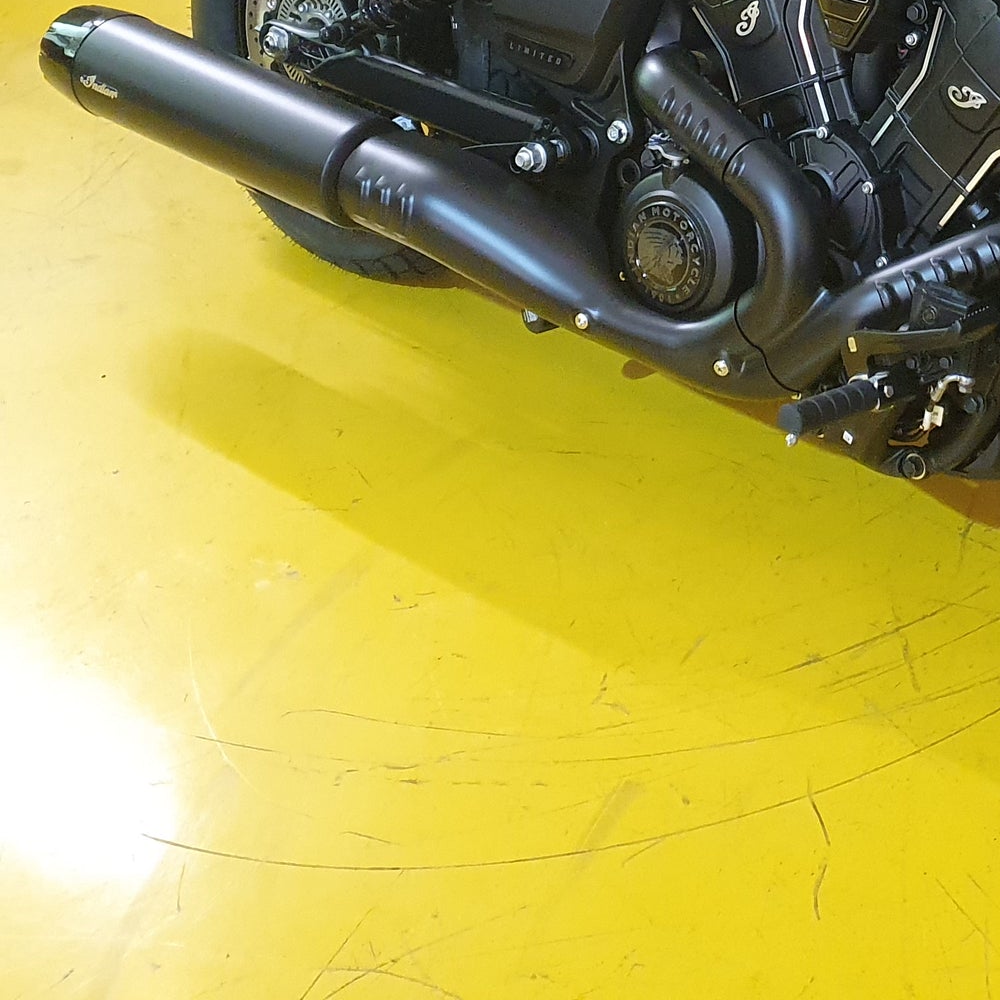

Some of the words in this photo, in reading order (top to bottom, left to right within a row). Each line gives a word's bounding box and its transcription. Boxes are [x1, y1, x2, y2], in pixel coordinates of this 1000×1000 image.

[509, 41, 562, 65] LIMITED
[79, 74, 118, 99] Indian
[651, 205, 702, 295] MOTORCYCLE
